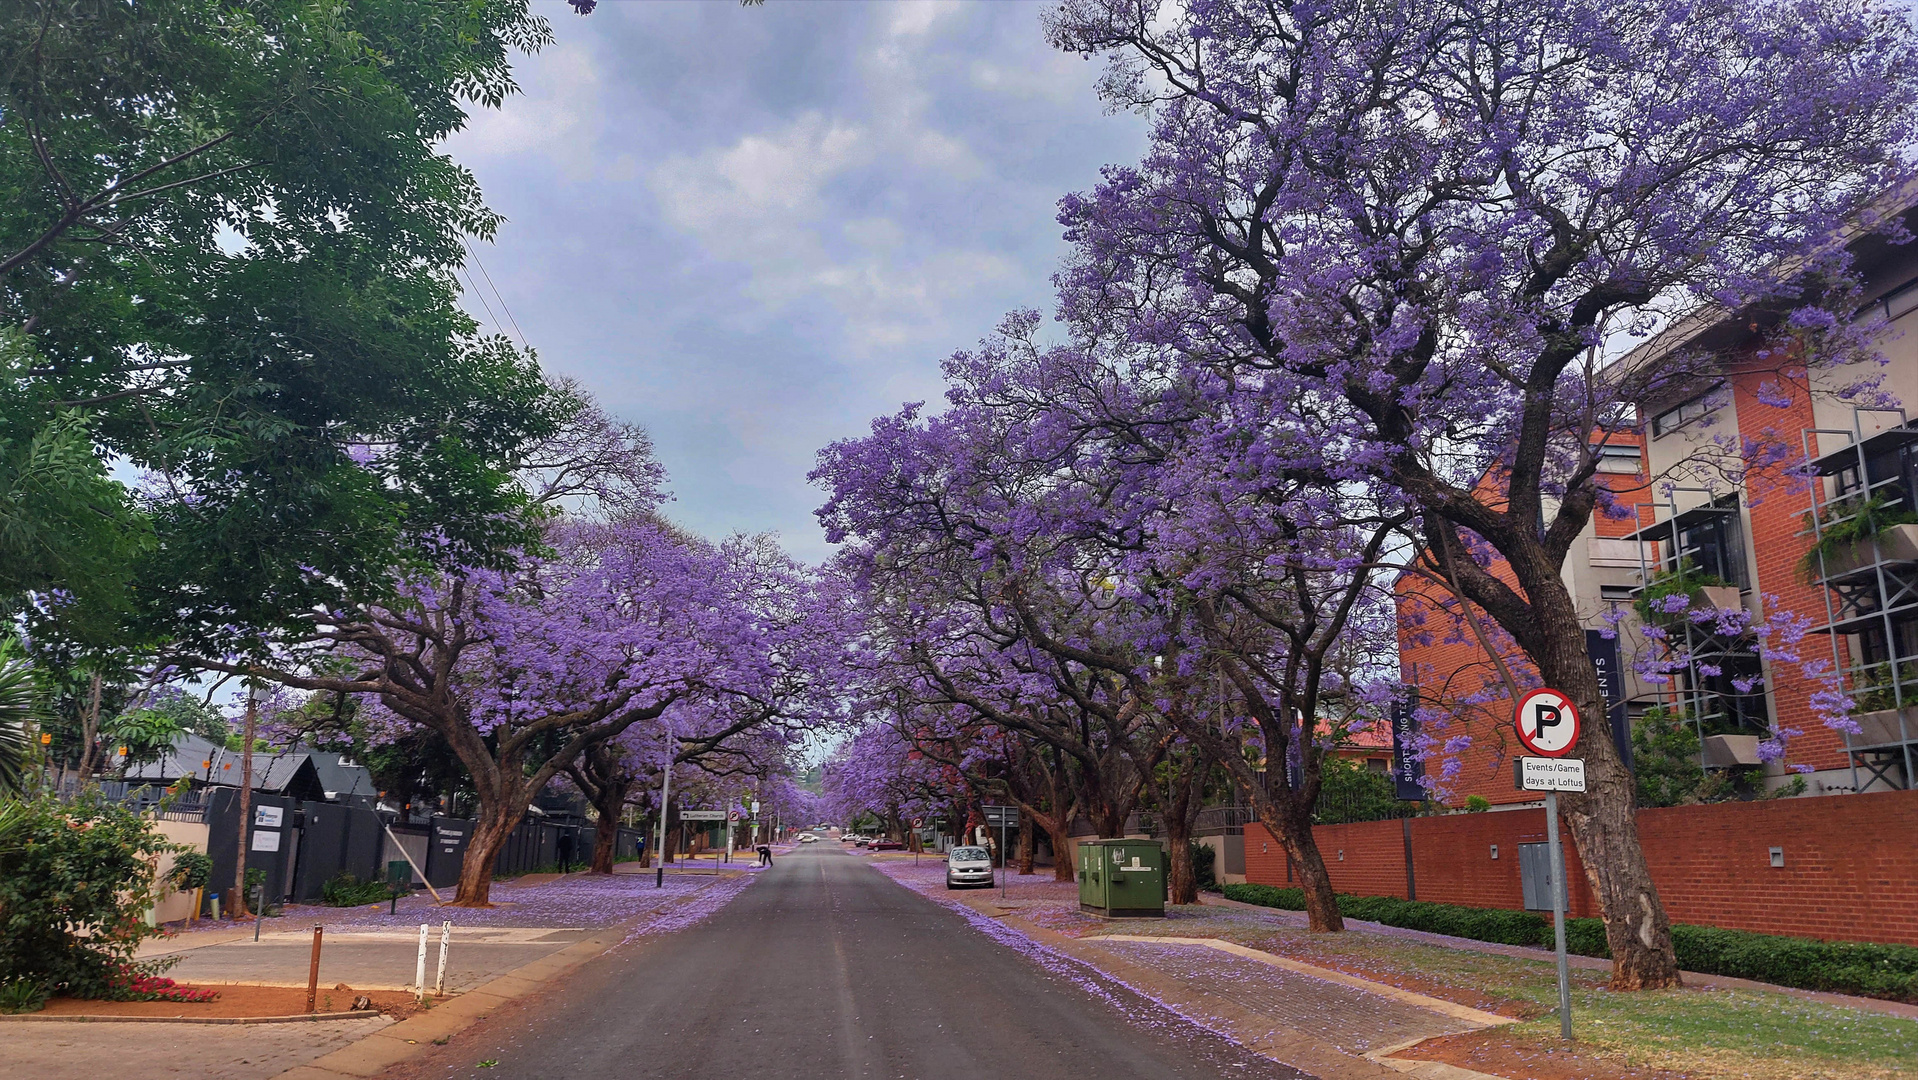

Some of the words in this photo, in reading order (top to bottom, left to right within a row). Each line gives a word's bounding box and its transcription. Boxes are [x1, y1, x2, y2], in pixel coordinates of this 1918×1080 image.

[1536, 704, 1562, 739] P
[1403, 751, 1413, 782] SHORT
[1526, 762, 1580, 773] Events/Game
[1525, 776, 1545, 786] days
[1547, 778, 1556, 786] at
[1558, 777, 1583, 787] Loftus
